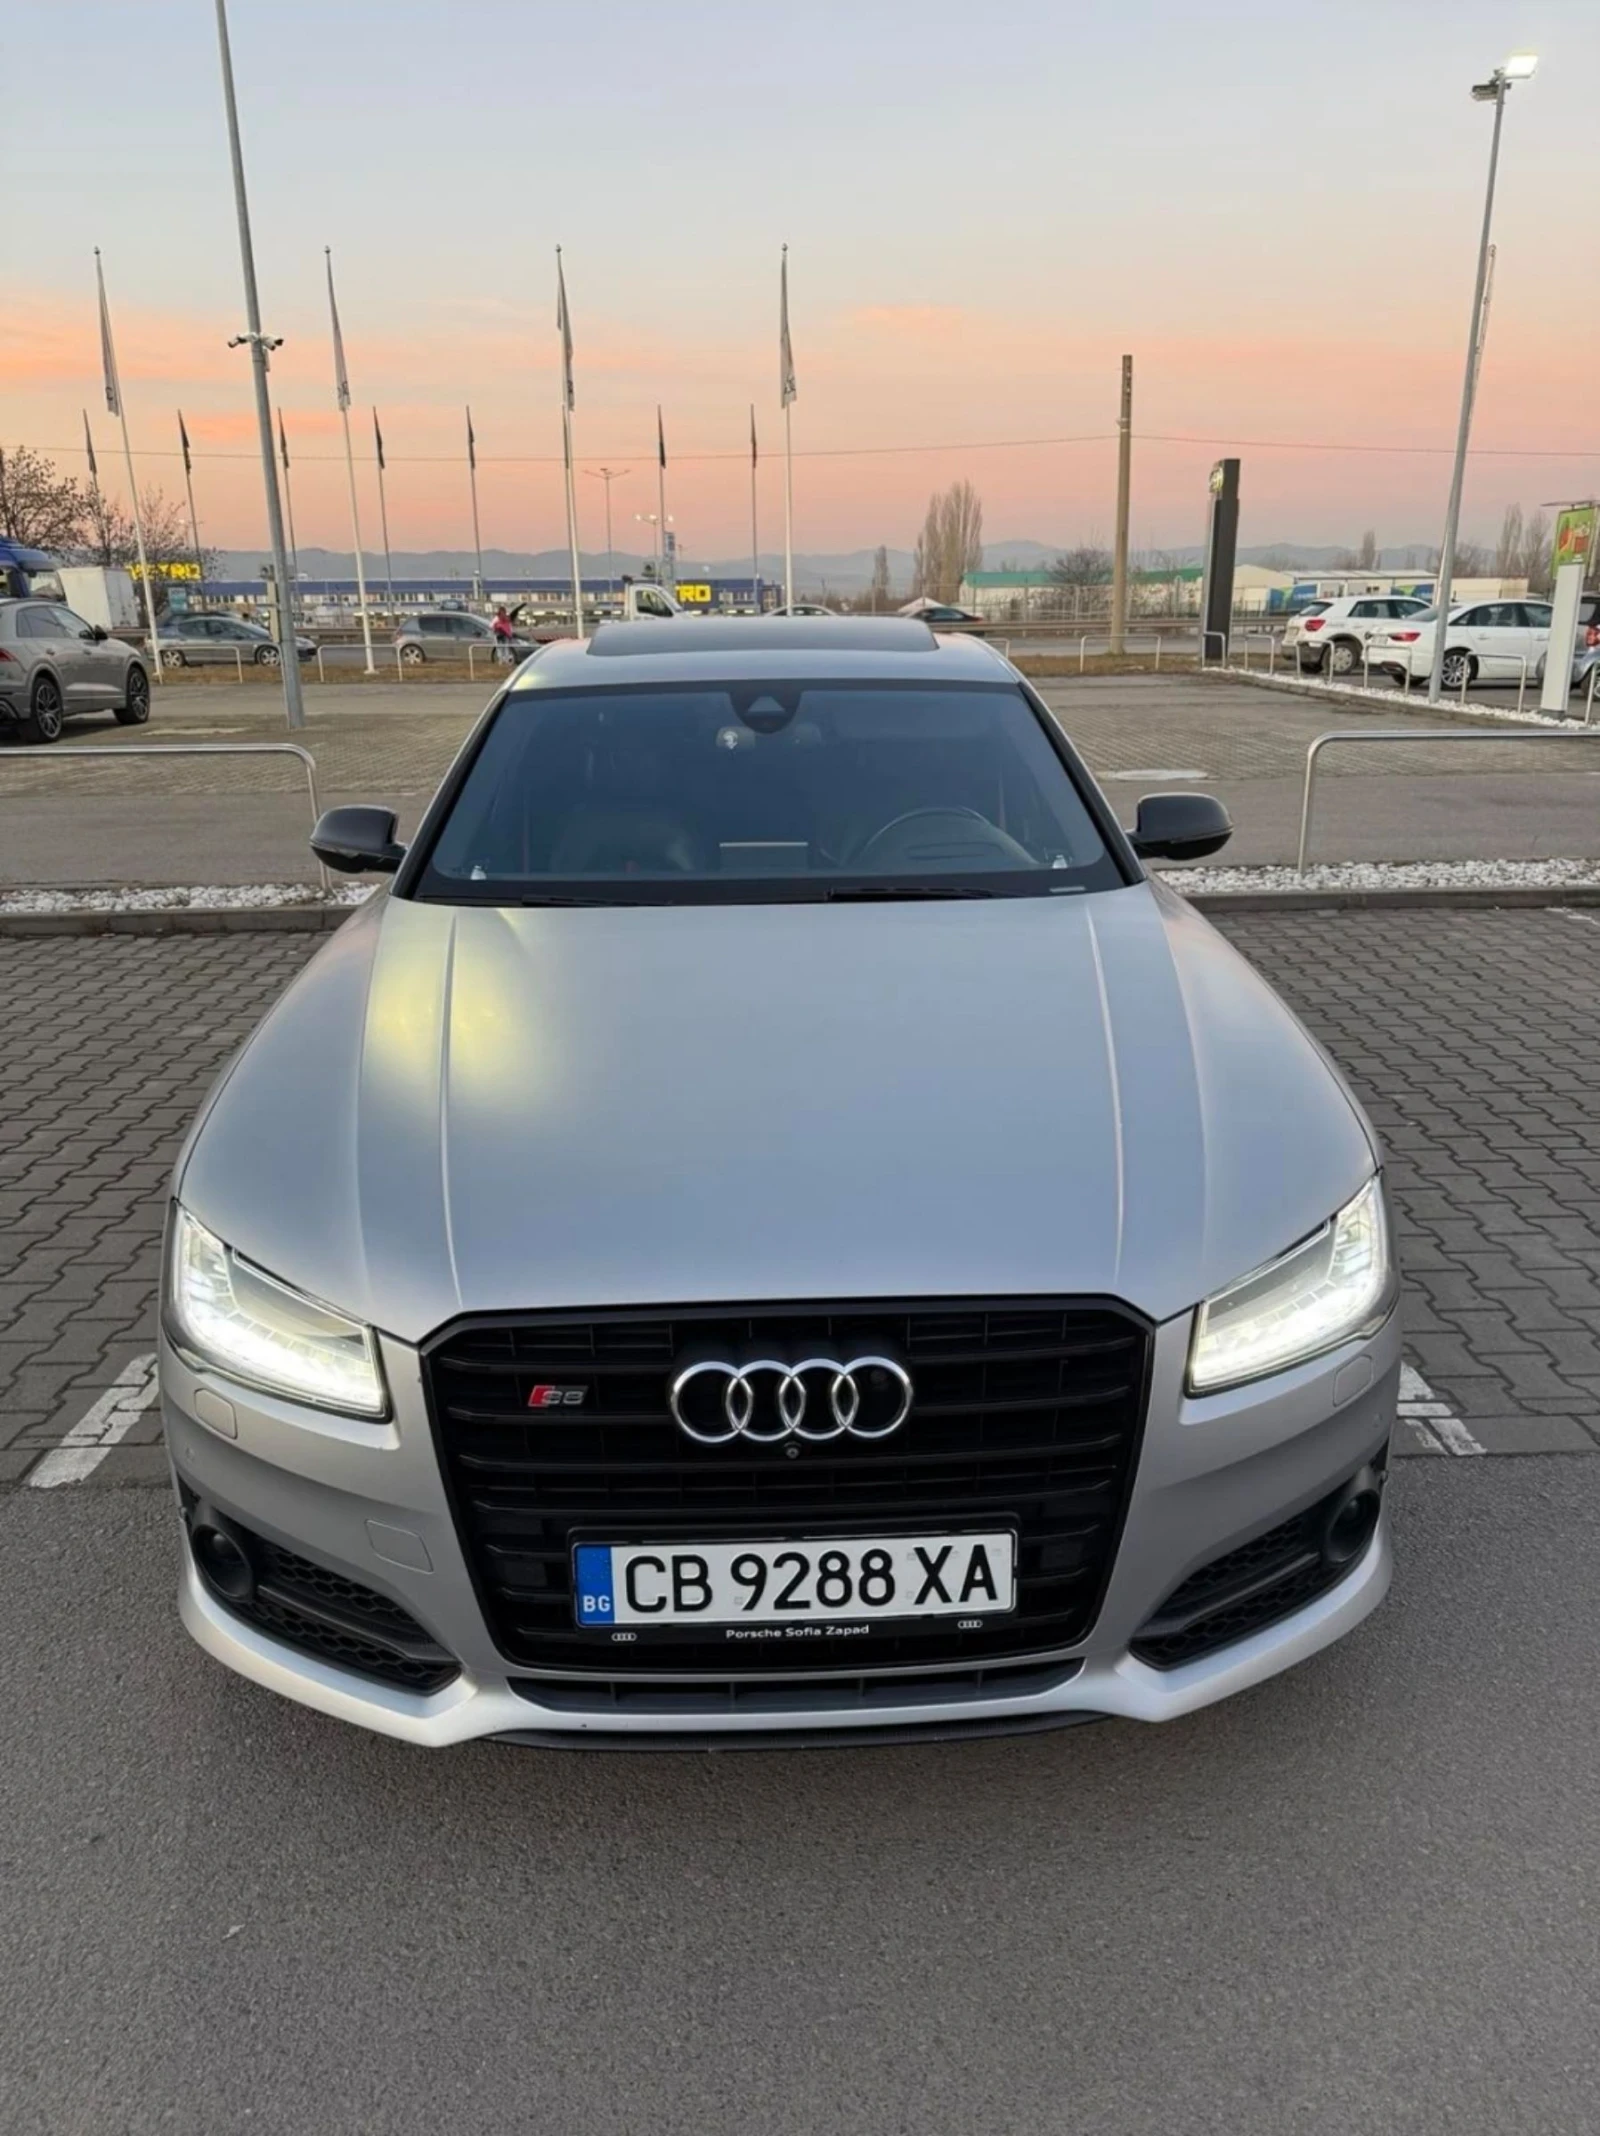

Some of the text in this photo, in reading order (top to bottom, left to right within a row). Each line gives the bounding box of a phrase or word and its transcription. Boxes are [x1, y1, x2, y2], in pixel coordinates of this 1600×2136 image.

[625, 1544, 998, 1613] CB 9288 XA
[583, 1595, 611, 1613] BG
[726, 1624, 870, 1639] Porsche Sofia Zapad
